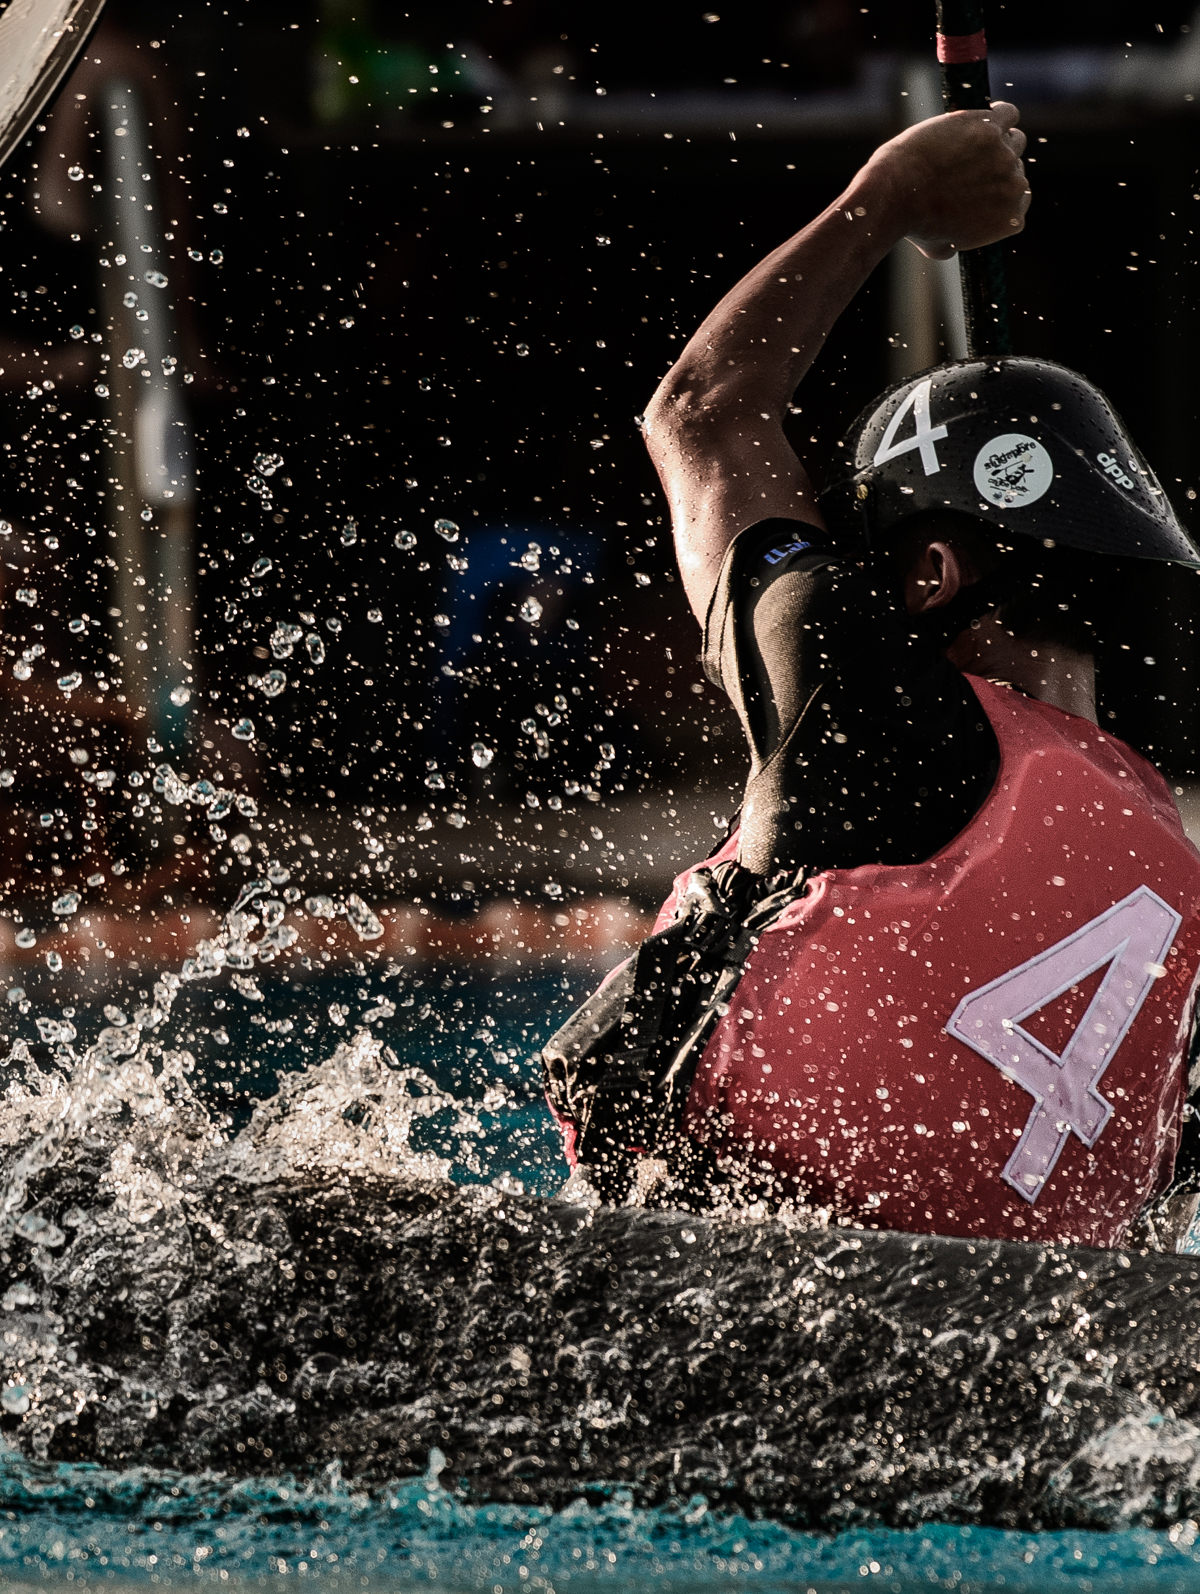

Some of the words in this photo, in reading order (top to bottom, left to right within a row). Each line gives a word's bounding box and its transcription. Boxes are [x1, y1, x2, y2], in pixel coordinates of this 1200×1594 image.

[873, 379, 949, 476] 4
[1096, 452, 1135, 490] dpp
[945, 884, 1183, 1204] 4
